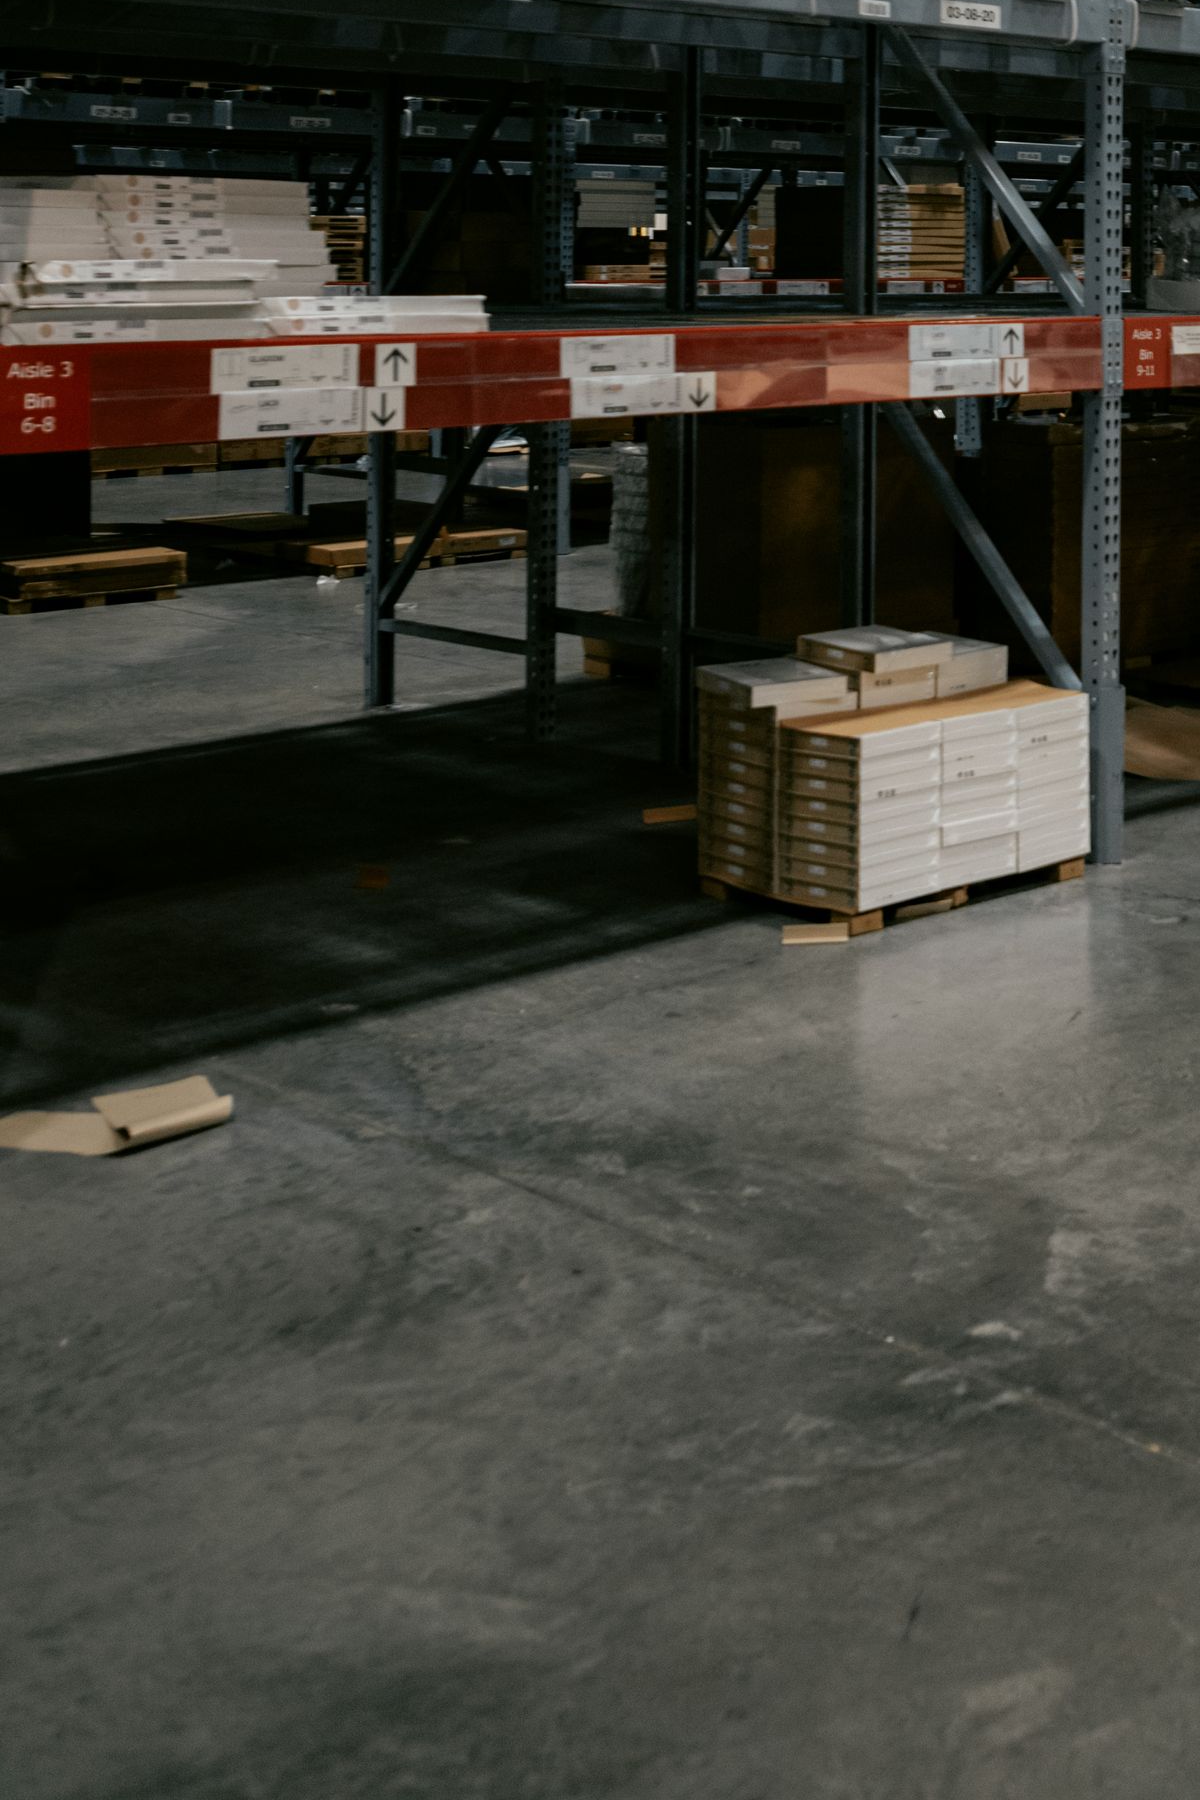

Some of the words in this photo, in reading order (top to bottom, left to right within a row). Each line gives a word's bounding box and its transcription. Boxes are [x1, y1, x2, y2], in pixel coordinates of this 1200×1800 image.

[1132, 328, 1153, 340] Aisle
[1155, 328, 1162, 340] 3
[1139, 349, 1154, 360] Bin
[6, 362, 54, 378] Aisle
[60, 360, 74, 377] 3
[1136, 365, 1155, 376] 9-11
[24, 392, 56, 410] Bin
[21, 416, 56, 433] 6-8
